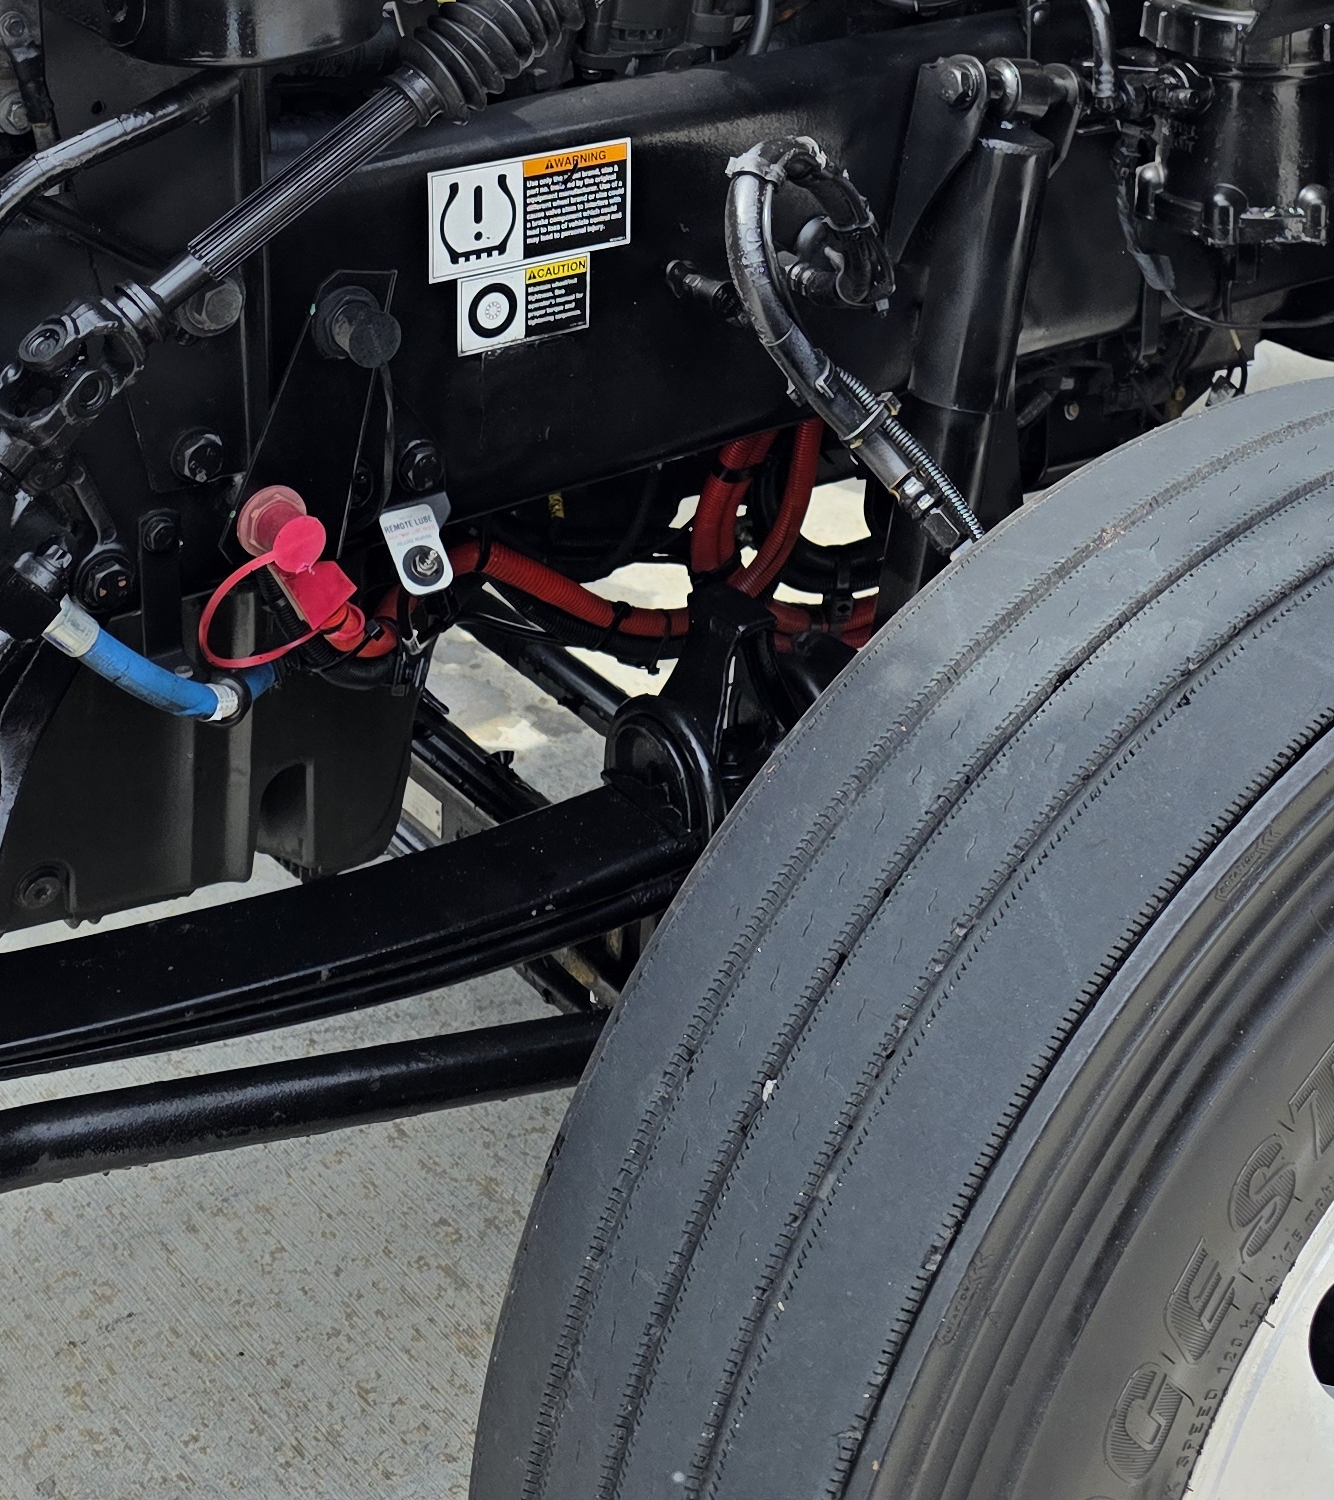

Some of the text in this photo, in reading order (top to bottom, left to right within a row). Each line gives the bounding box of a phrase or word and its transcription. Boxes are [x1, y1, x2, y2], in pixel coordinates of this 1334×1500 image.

[554, 151, 607, 167] WARNING
[537, 260, 586, 278] CAUTION
[384, 520, 413, 534] REMOTE
[414, 514, 432, 526] LUBE
[1176, 1389, 1219, 1469] SPEED
[1217, 1337, 1243, 1375] 120
